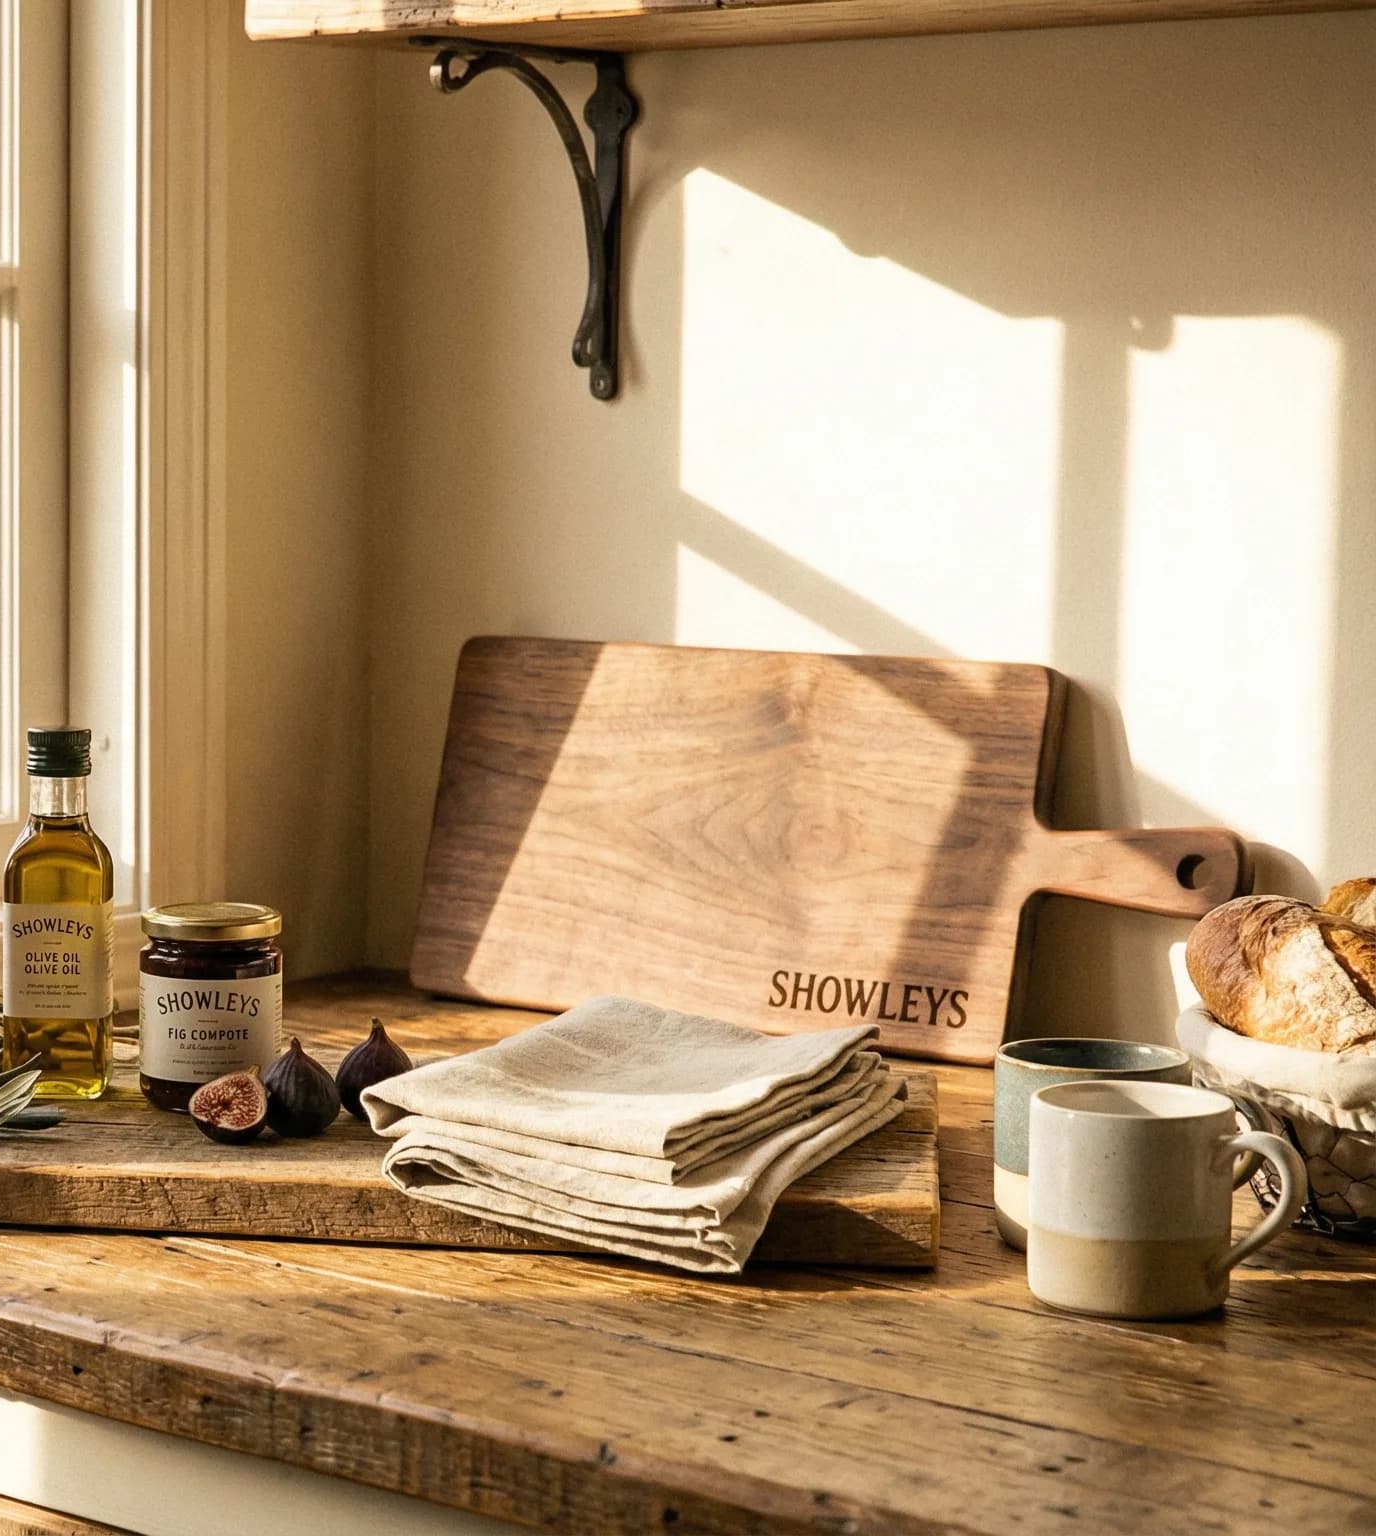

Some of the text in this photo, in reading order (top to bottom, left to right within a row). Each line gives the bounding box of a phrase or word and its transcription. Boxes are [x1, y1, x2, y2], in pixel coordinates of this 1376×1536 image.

[12, 918, 94, 940] SHOWLEYS
[25, 952, 81, 963] OLIVE OIL
[24, 964, 81, 975] OLIVE OIL
[157, 990, 260, 1017] SHOWLEYS
[768, 970, 969, 1029] SHOWLEYS
[168, 1027, 249, 1041] FIG COMPOTE
